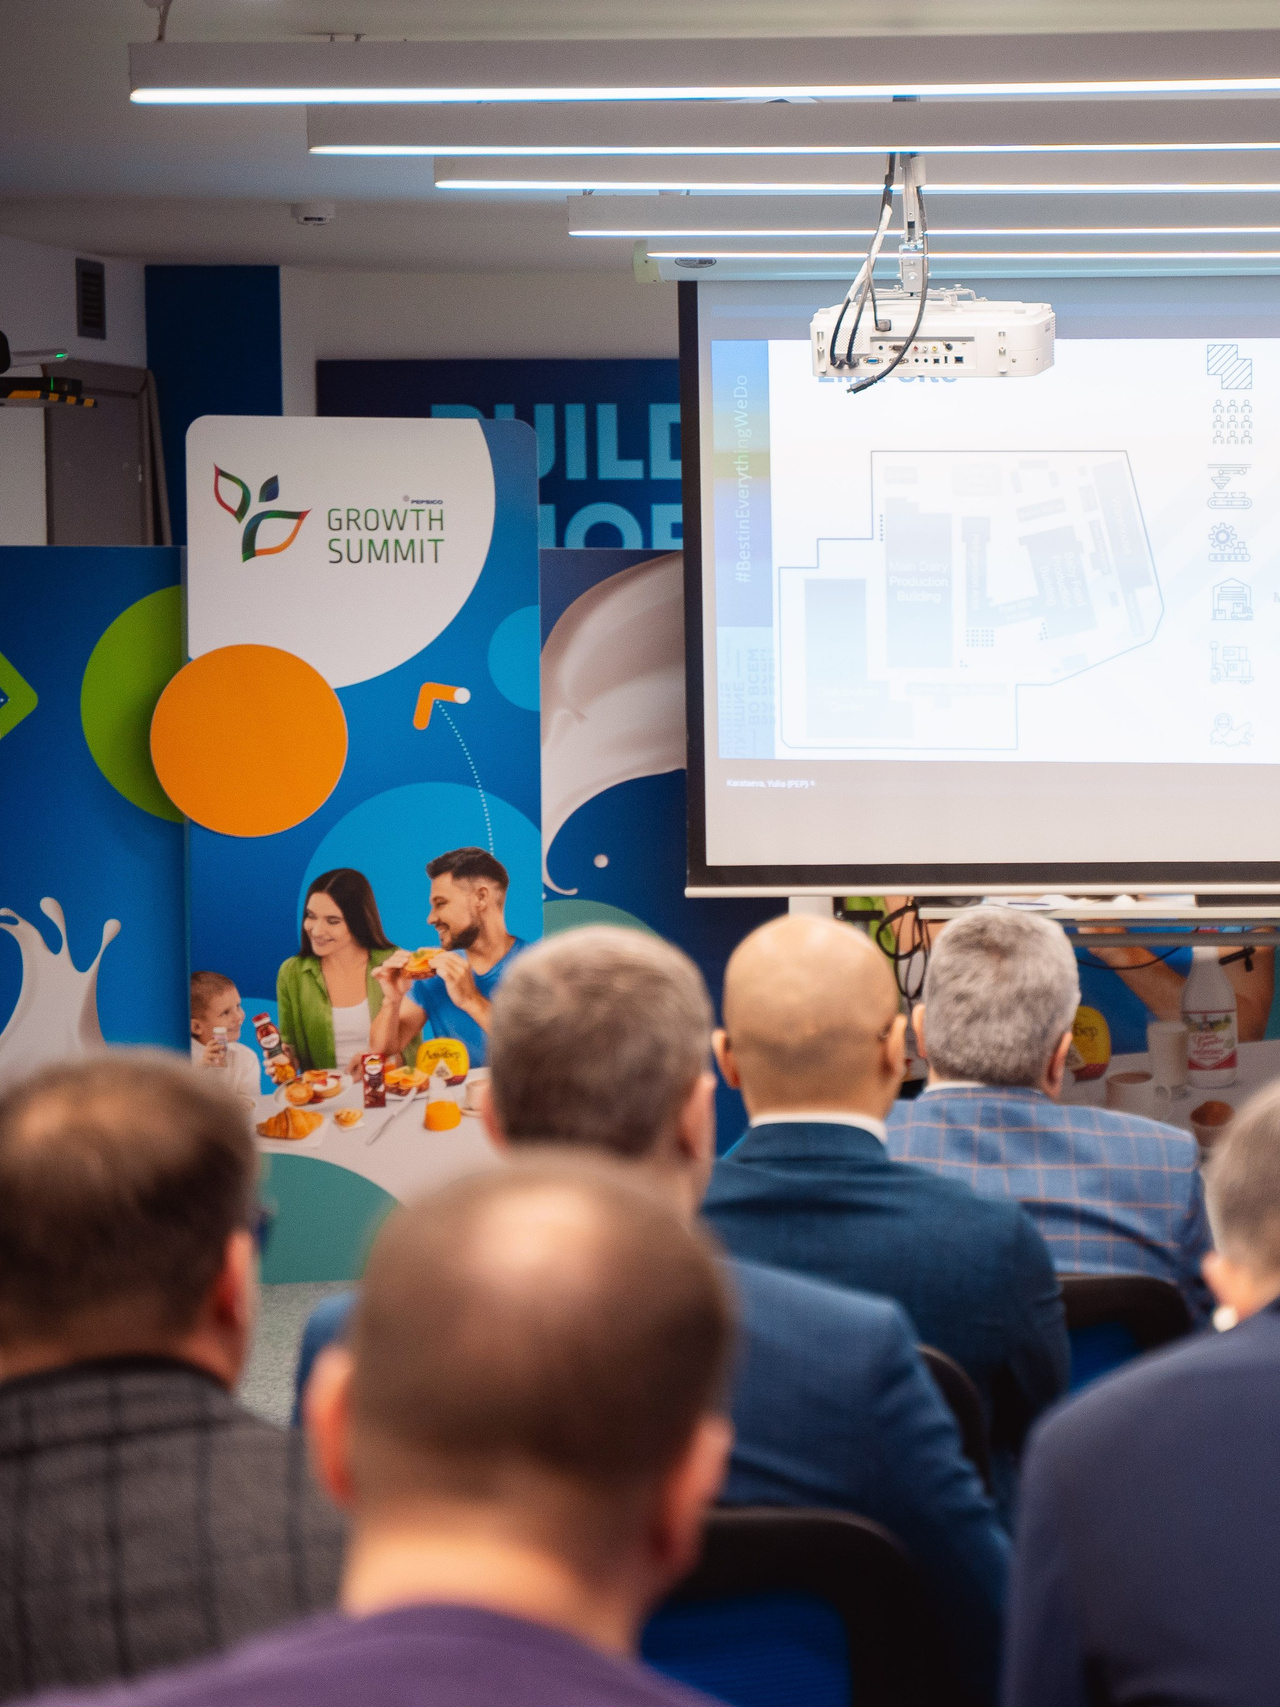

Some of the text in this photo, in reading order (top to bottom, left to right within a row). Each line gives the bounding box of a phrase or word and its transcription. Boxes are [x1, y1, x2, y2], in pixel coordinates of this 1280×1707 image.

[732, 374, 753, 584] #BestinEverythingWeDo
[327, 508, 444, 531] GROWTH
[328, 538, 445, 563] SUMMIT
[888, 575, 949, 587] Production
